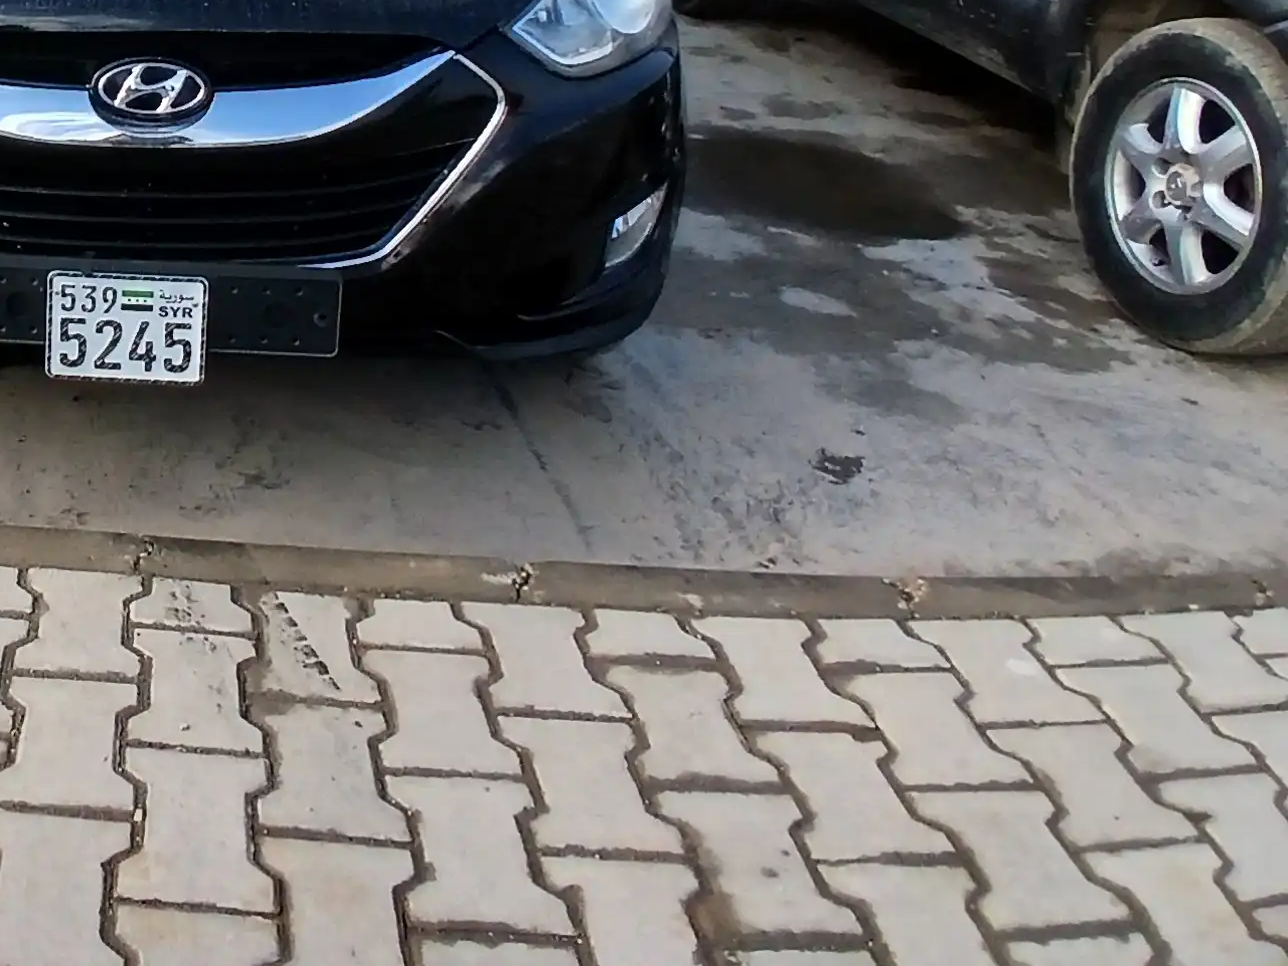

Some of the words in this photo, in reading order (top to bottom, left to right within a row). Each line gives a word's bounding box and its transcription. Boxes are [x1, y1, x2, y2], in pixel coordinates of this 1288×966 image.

[61, 284, 118, 314] 539
[159, 289, 195, 304] سورية
[158, 305, 193, 319] SYR
[59, 317, 192, 374] 5245
